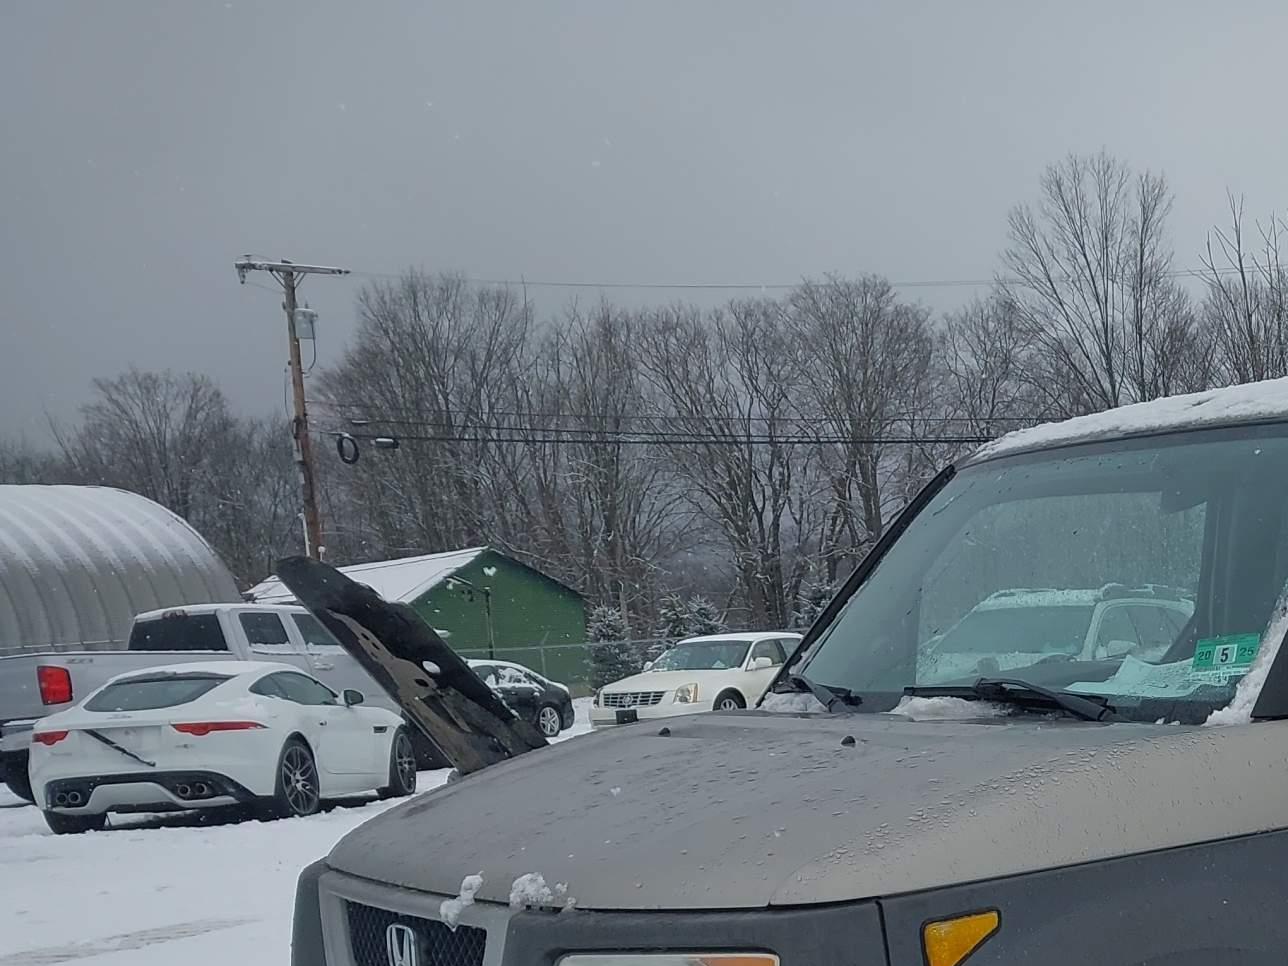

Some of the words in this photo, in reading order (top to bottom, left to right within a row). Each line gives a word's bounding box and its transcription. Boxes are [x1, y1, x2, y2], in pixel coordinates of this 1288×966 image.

[1198, 649, 1211, 661] 20
[1220, 647, 1230, 663] 5
[1240, 647, 1254, 657] 25
